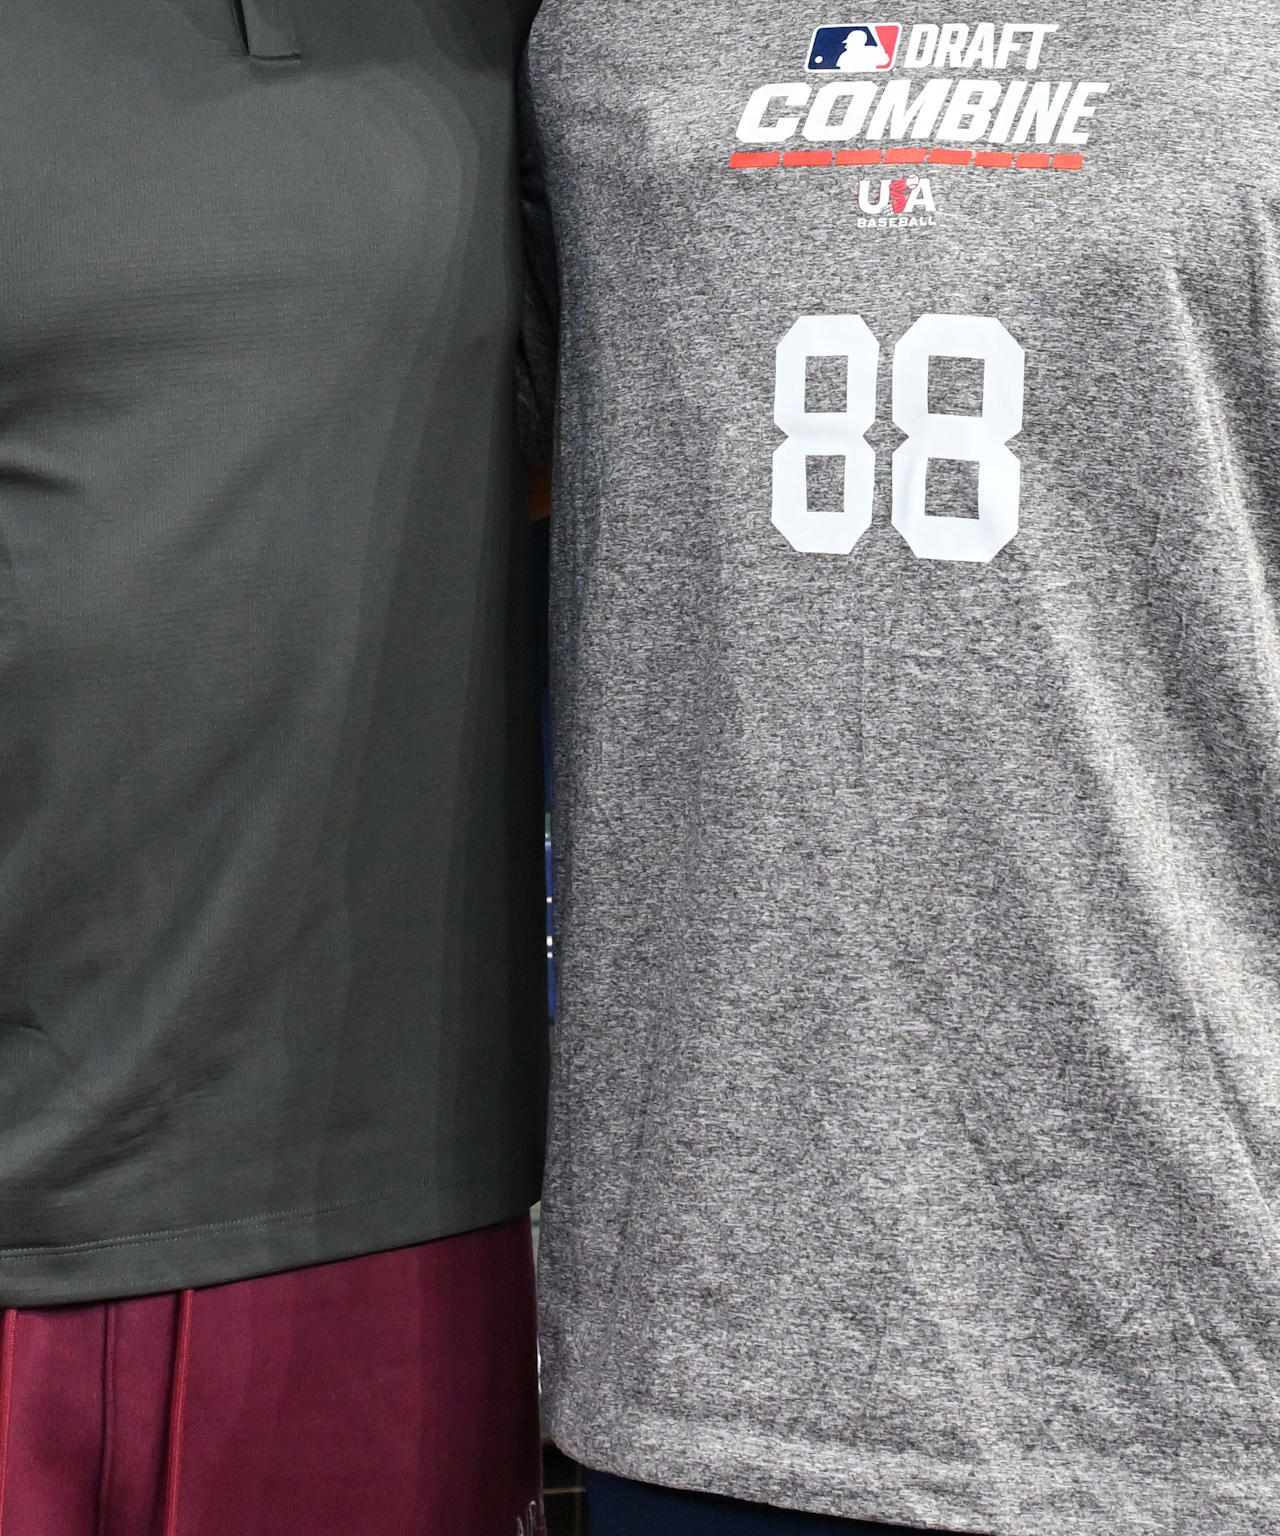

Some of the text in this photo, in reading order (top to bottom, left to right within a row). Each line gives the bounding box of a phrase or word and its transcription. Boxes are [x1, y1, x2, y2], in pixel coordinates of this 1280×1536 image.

[903, 22, 1060, 71] DRAFT
[735, 79, 1111, 145] COMBINE
[856, 216, 938, 228] BASEBALL
[770, 314, 1026, 563] 88
